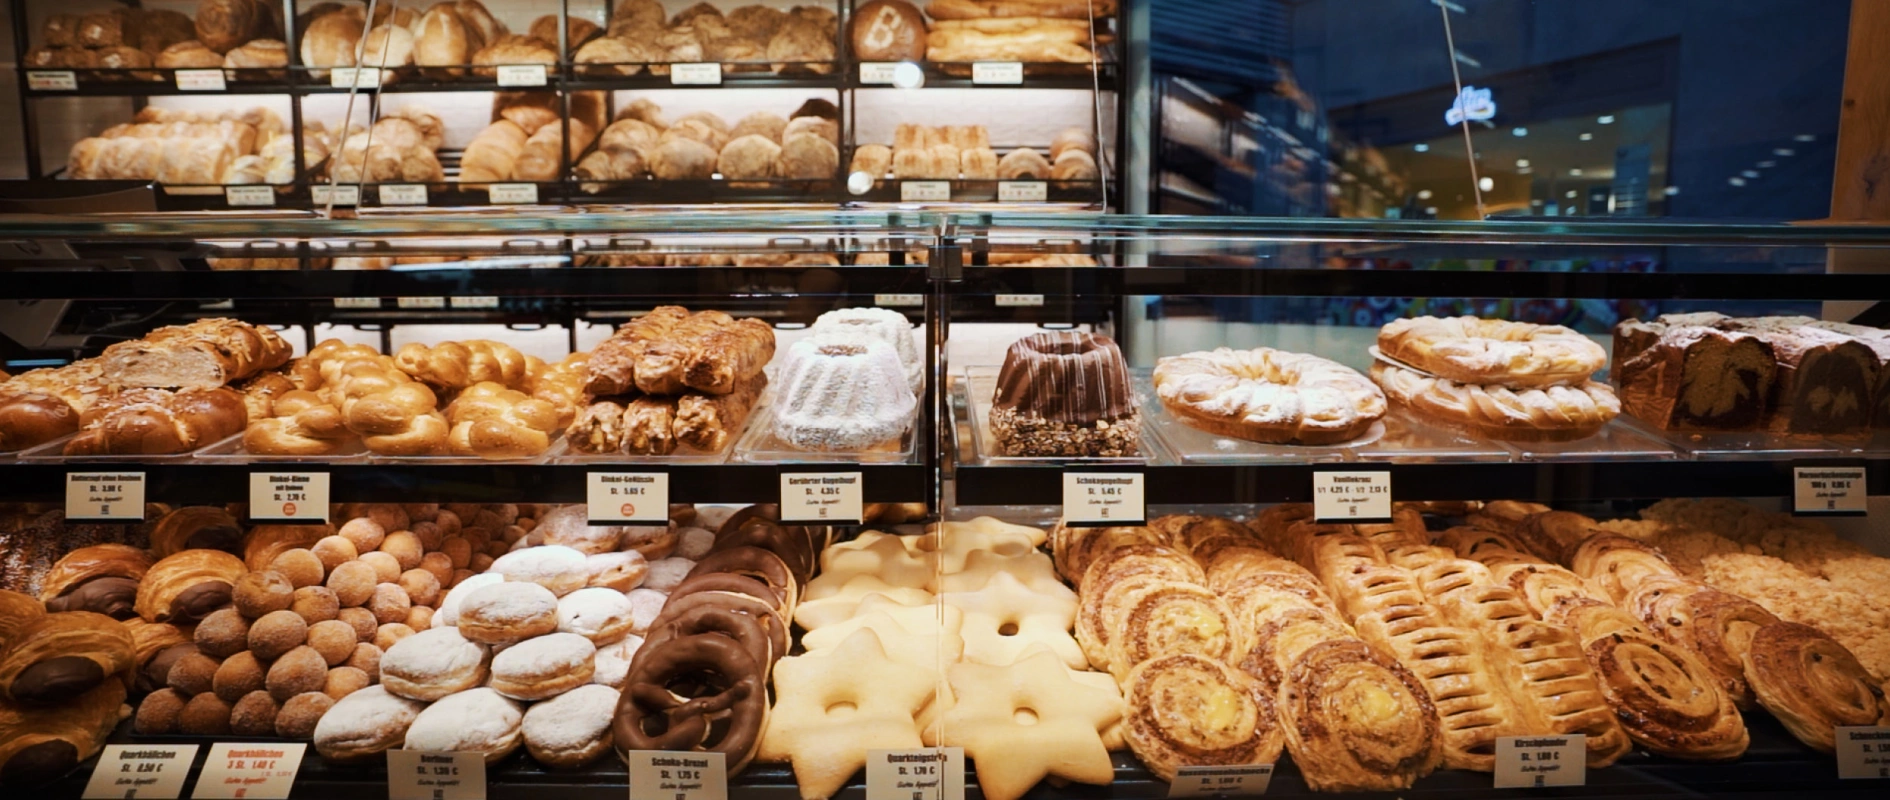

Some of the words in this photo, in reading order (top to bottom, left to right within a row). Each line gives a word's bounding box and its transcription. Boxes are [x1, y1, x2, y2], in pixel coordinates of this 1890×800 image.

[1333, 475, 1373, 483] Vanillekranz
[611, 487, 619, 495] St.
[806, 487, 814, 495] St.
[1088, 487, 1096, 495] St.
[274, 493, 282, 501] St.
[1863, 744, 1872, 753] St.
[119, 750, 177, 760] Quarkbällchen
[227, 749, 285, 759] Quarkbällchen
[1521, 753, 1531, 761] St.
[227, 760, 234, 769] 3
[235, 760, 245, 769] St.
[651, 758, 709, 768] Schoko-Brezel
[121, 763, 131, 773] St.
[417, 766, 427, 775] St.
[898, 766, 909, 775] St.
[660, 770, 671, 779] St.
